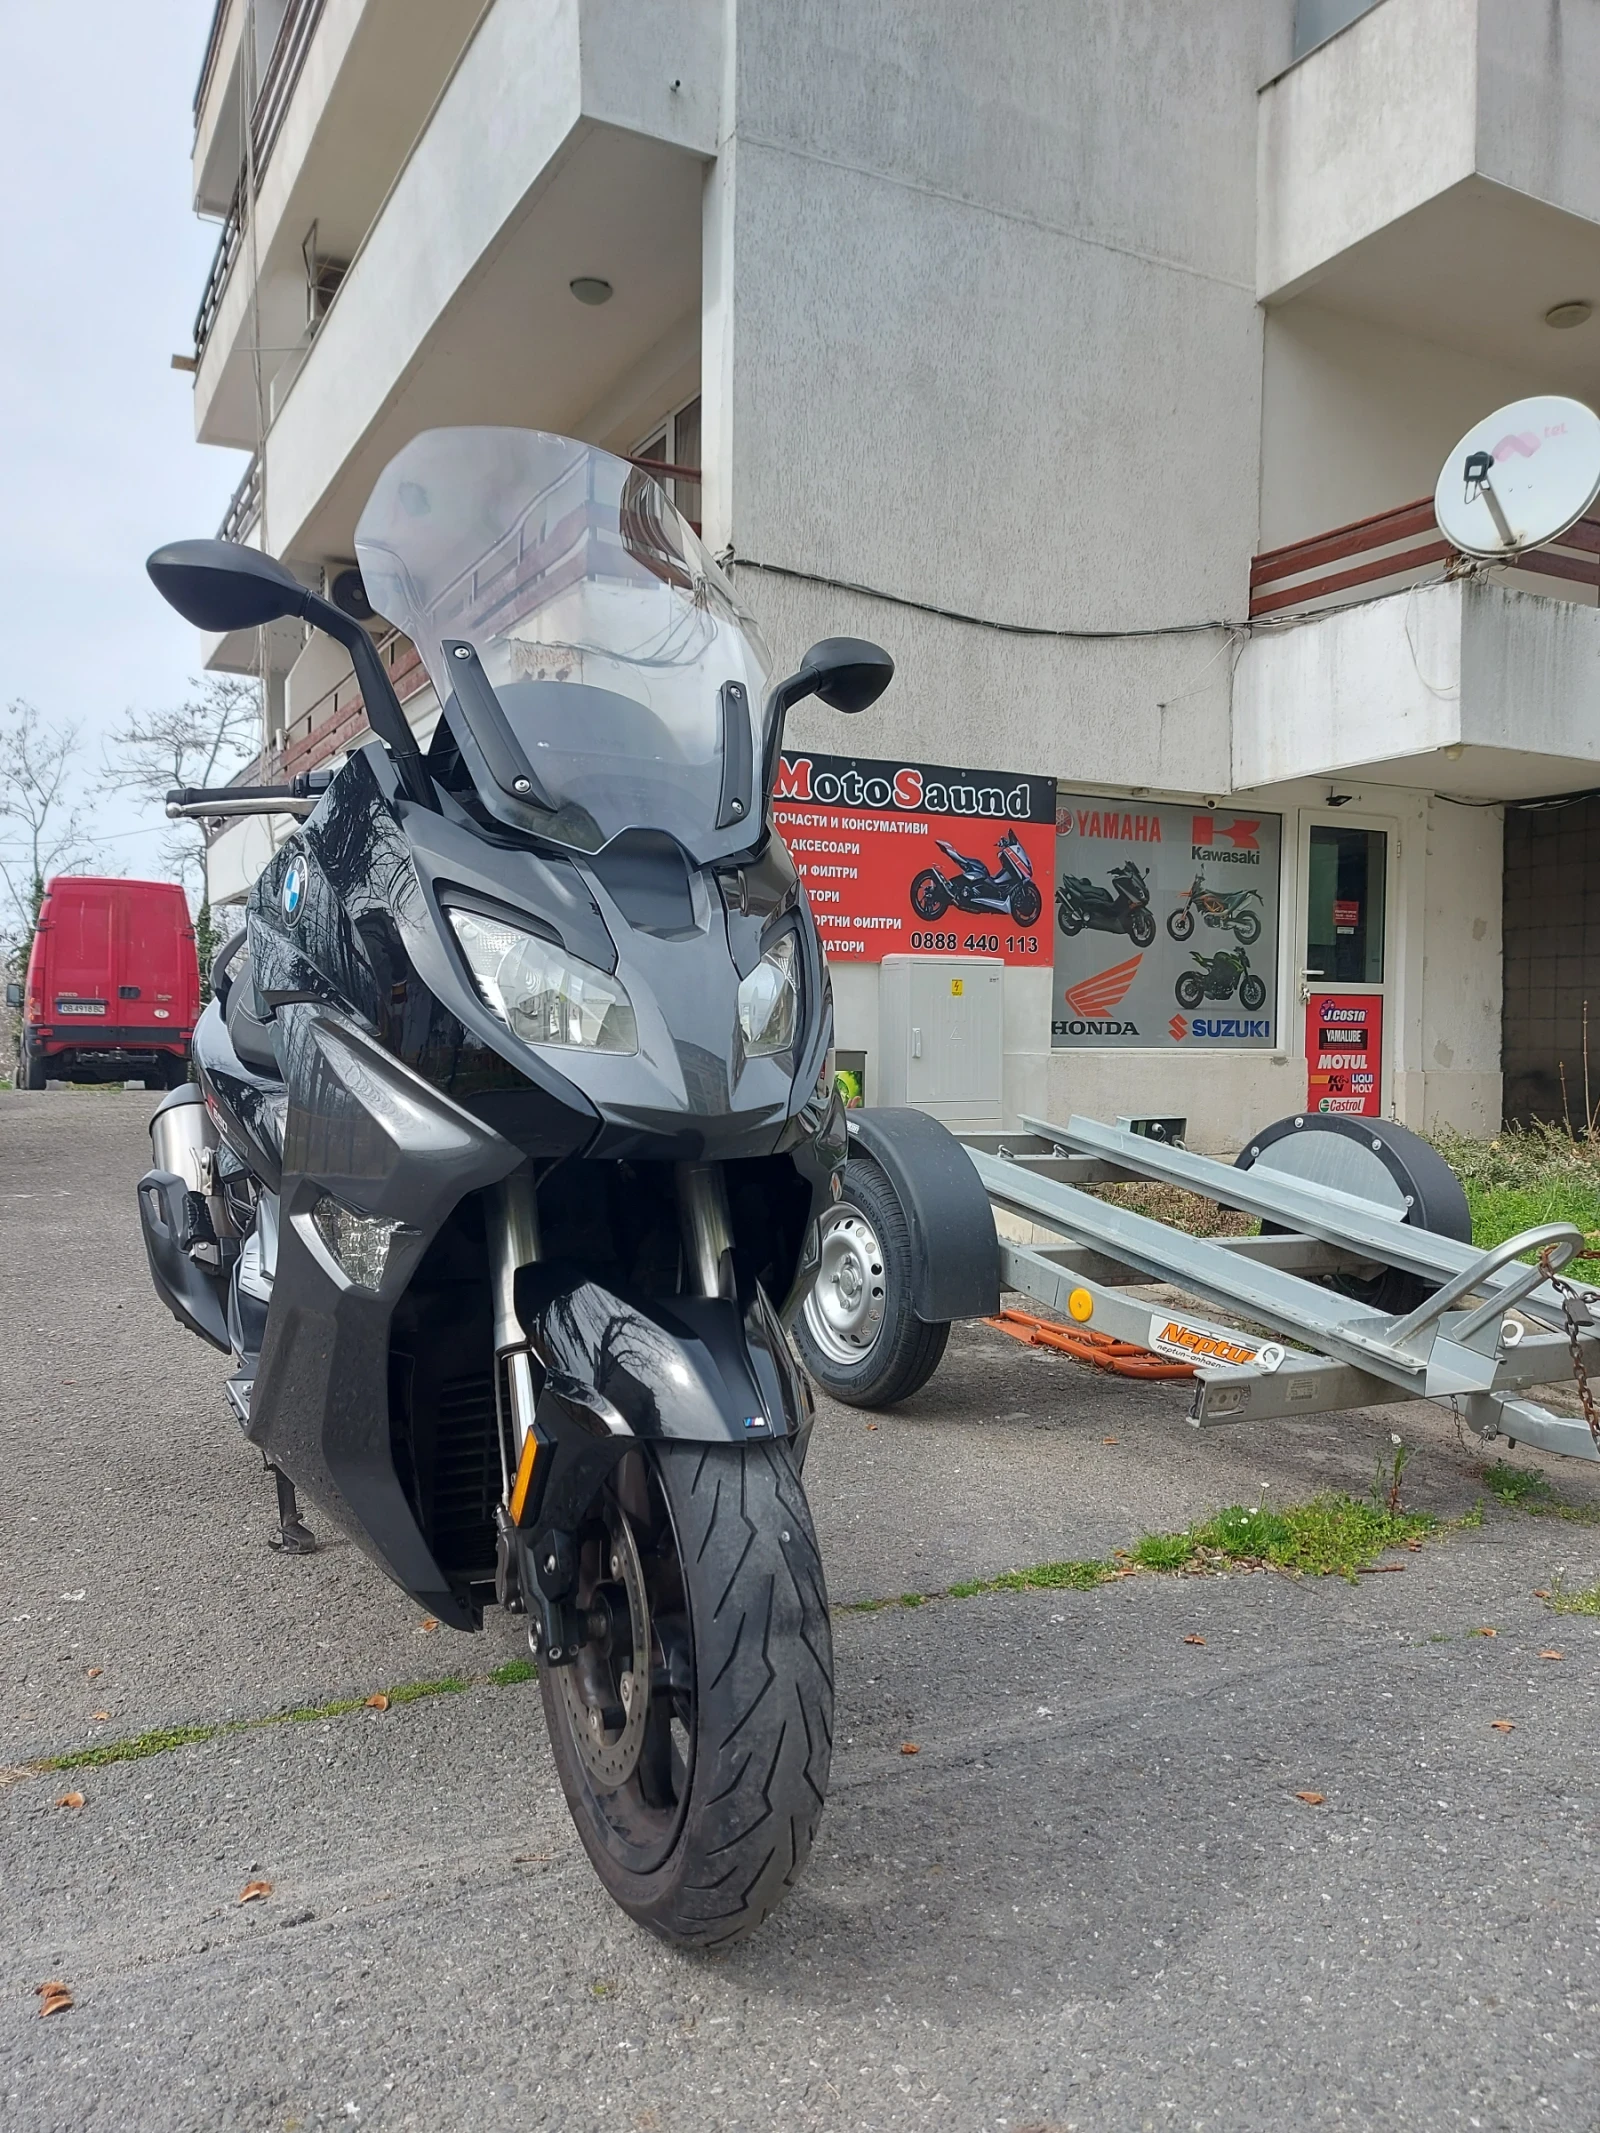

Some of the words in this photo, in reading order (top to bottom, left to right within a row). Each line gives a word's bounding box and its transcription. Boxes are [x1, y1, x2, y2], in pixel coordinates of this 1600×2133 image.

[773, 756, 1031, 819] MotoSaund
[830, 816, 839, 829] И
[841, 817, 929, 836] КОНСУМАТИВИ
[1076, 810, 1162, 844] YAMAHA
[790, 838, 860, 855] АКСЕСОАРИ
[1191, 845, 1261, 866] Kawasaki
[798, 864, 807, 876] И
[810, 865, 858, 880] ФИЛТРИ
[853, 916, 902, 930] ФИЛТРИ
[911, 931, 957, 951] 0888
[963, 934, 1000, 952] 440
[1005, 936, 1038, 953] 113
[1051, 1020, 1140, 1036] HONDA
[1192, 1019, 1270, 1038] SUZUKI
[1326, 1028, 1363, 1043] YAMALUBE
[1317, 1054, 1368, 1070] MOTUL
[1351, 1073, 1374, 1084] LIQUI
[1351, 1083, 1374, 1094] MOLY
[1330, 1099, 1362, 1112] Castrol
